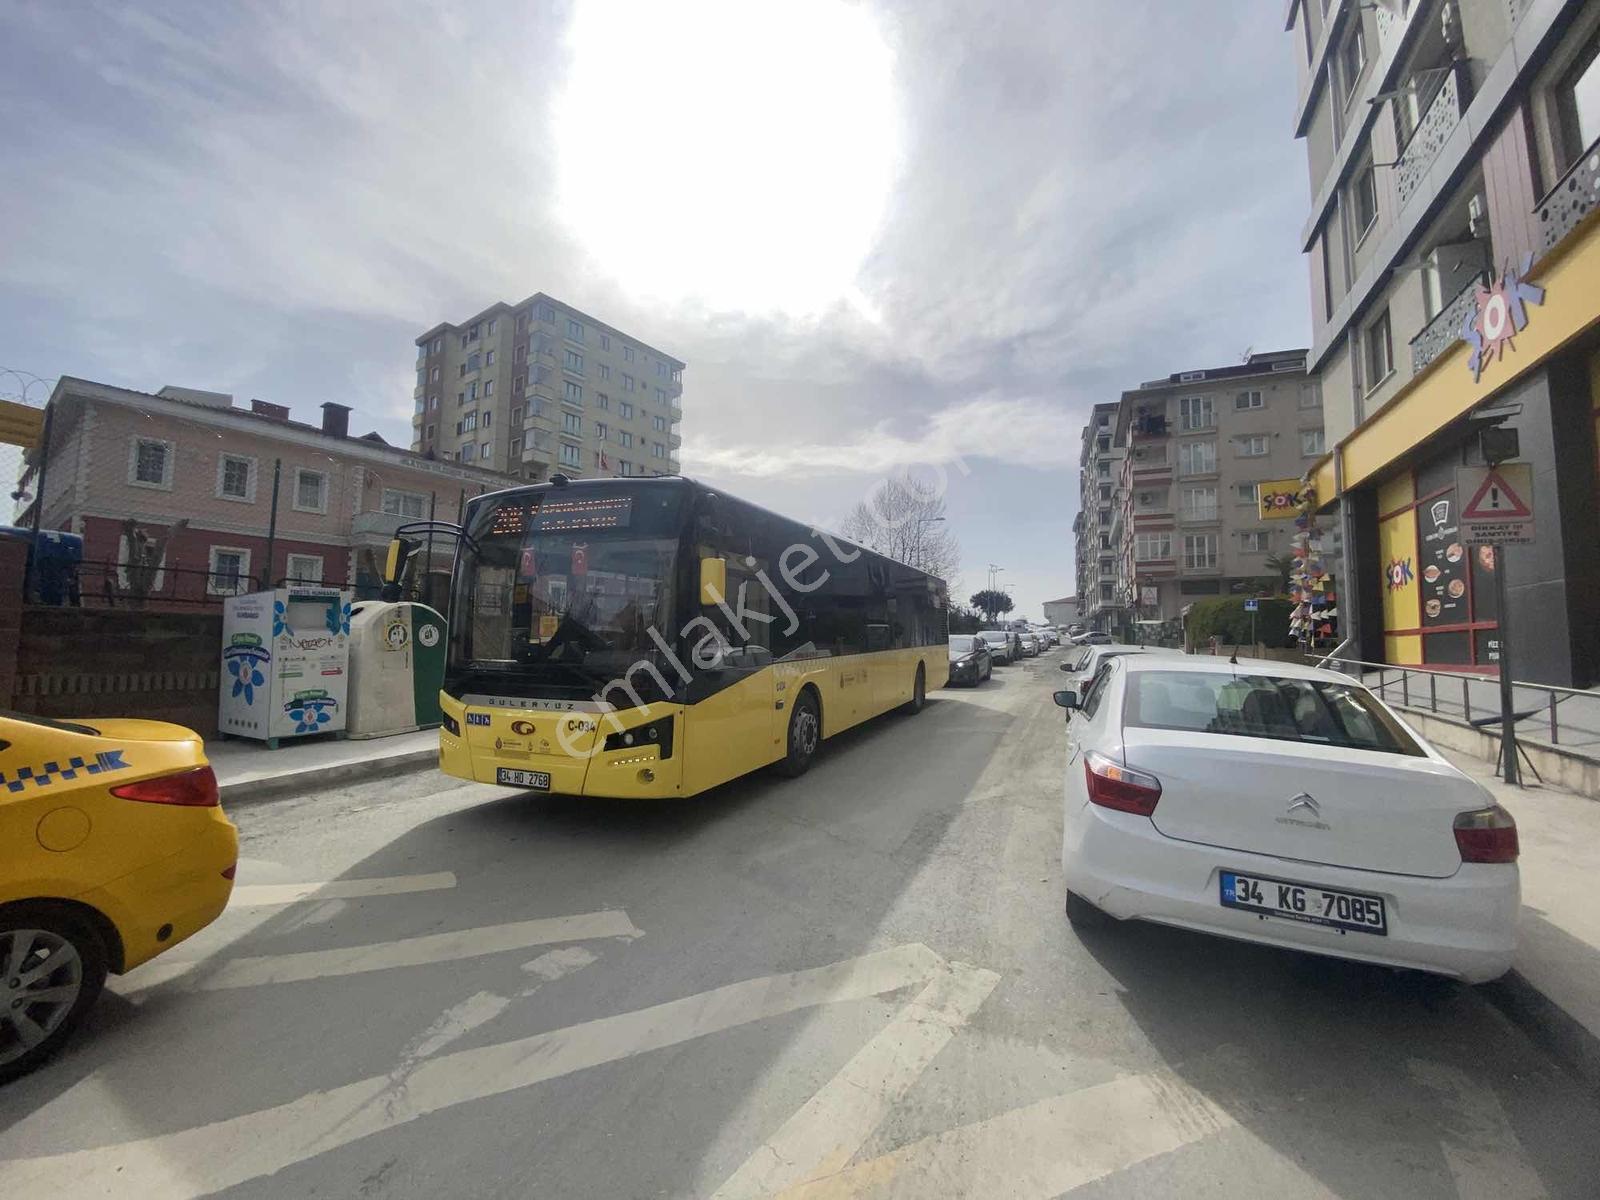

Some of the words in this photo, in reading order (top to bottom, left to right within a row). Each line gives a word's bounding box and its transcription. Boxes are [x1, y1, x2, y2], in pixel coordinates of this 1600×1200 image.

[1236, 878, 1264, 905] 34
[1277, 885, 1306, 912] KG
[1321, 892, 1381, 926] 7085
